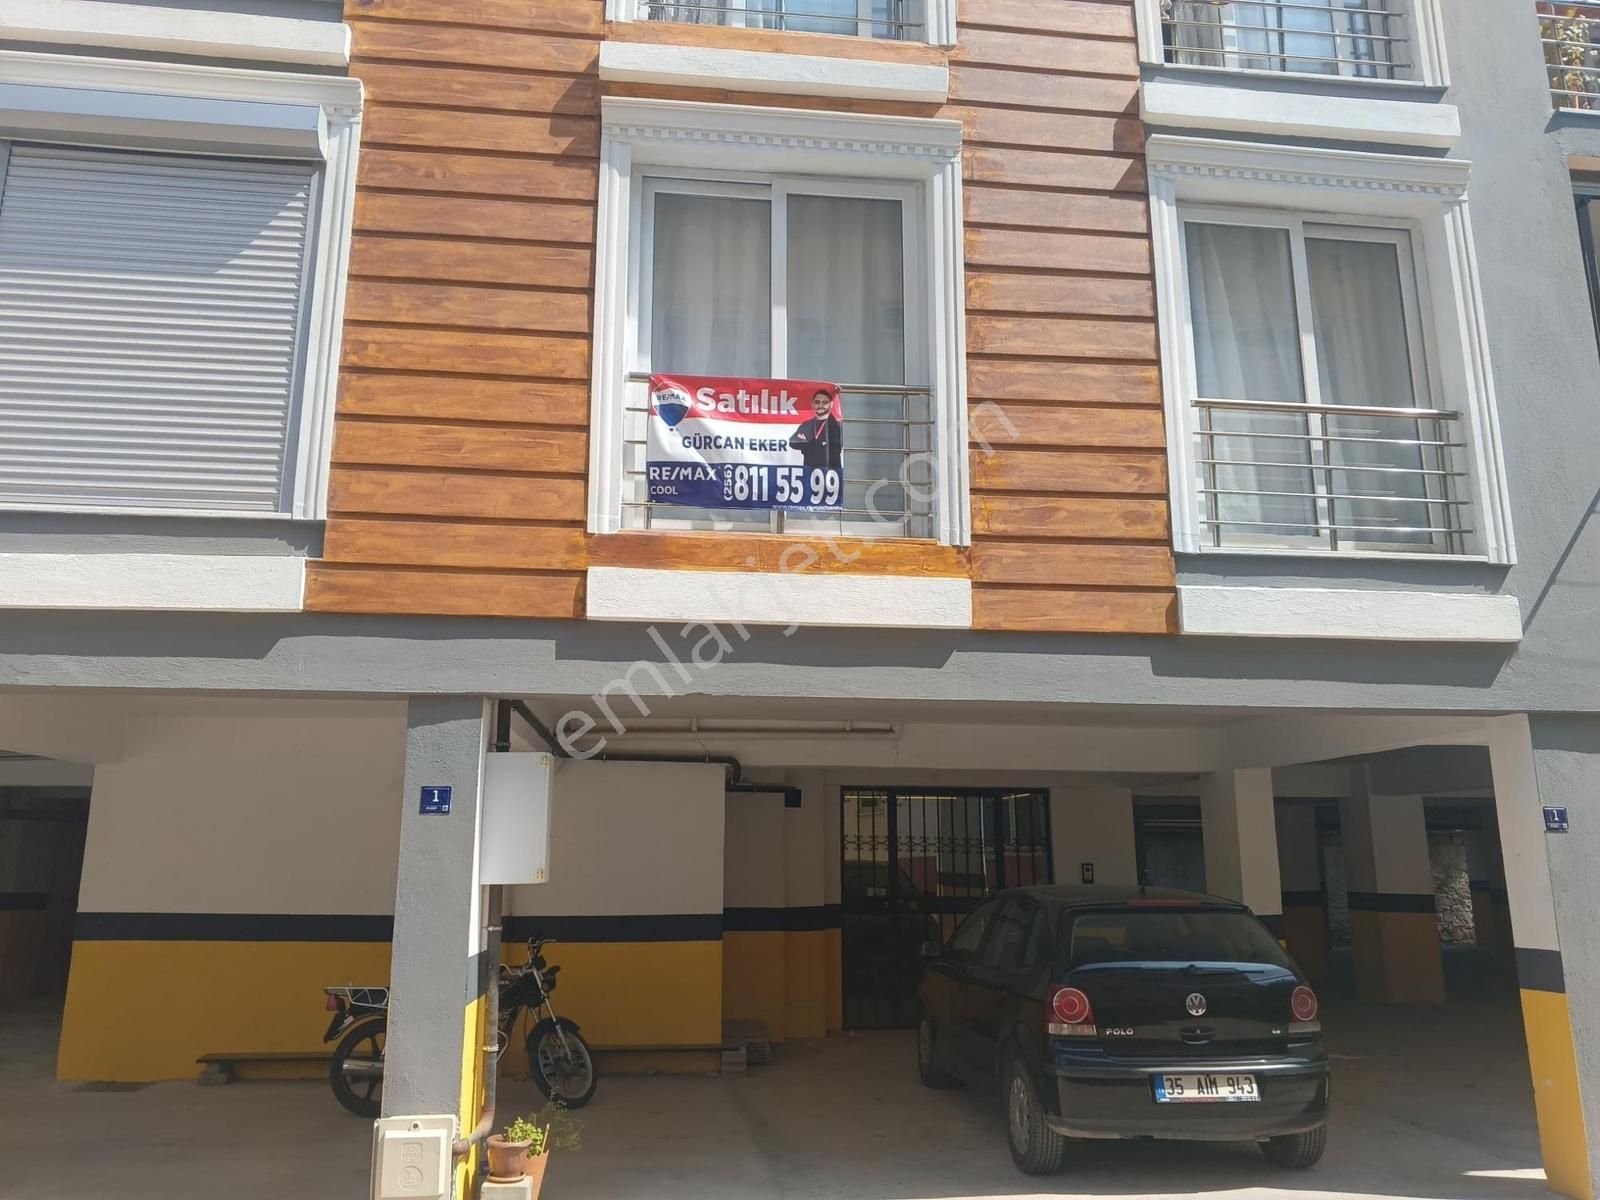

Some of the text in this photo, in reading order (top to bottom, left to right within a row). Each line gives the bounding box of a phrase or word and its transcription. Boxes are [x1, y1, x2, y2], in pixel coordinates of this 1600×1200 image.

[696, 387, 799, 416] Satılık
[682, 433, 788, 452] GÜRCAN EKER
[650, 466, 717, 481] RE/MAX
[650, 485, 679, 495] COOL
[723, 464, 840, 505] (256) 811 55 99
[432, 790, 439, 802] 1
[1553, 810, 1559, 821] 1
[1165, 1077, 1185, 1096] 35
[1226, 1076, 1254, 1095] 943
